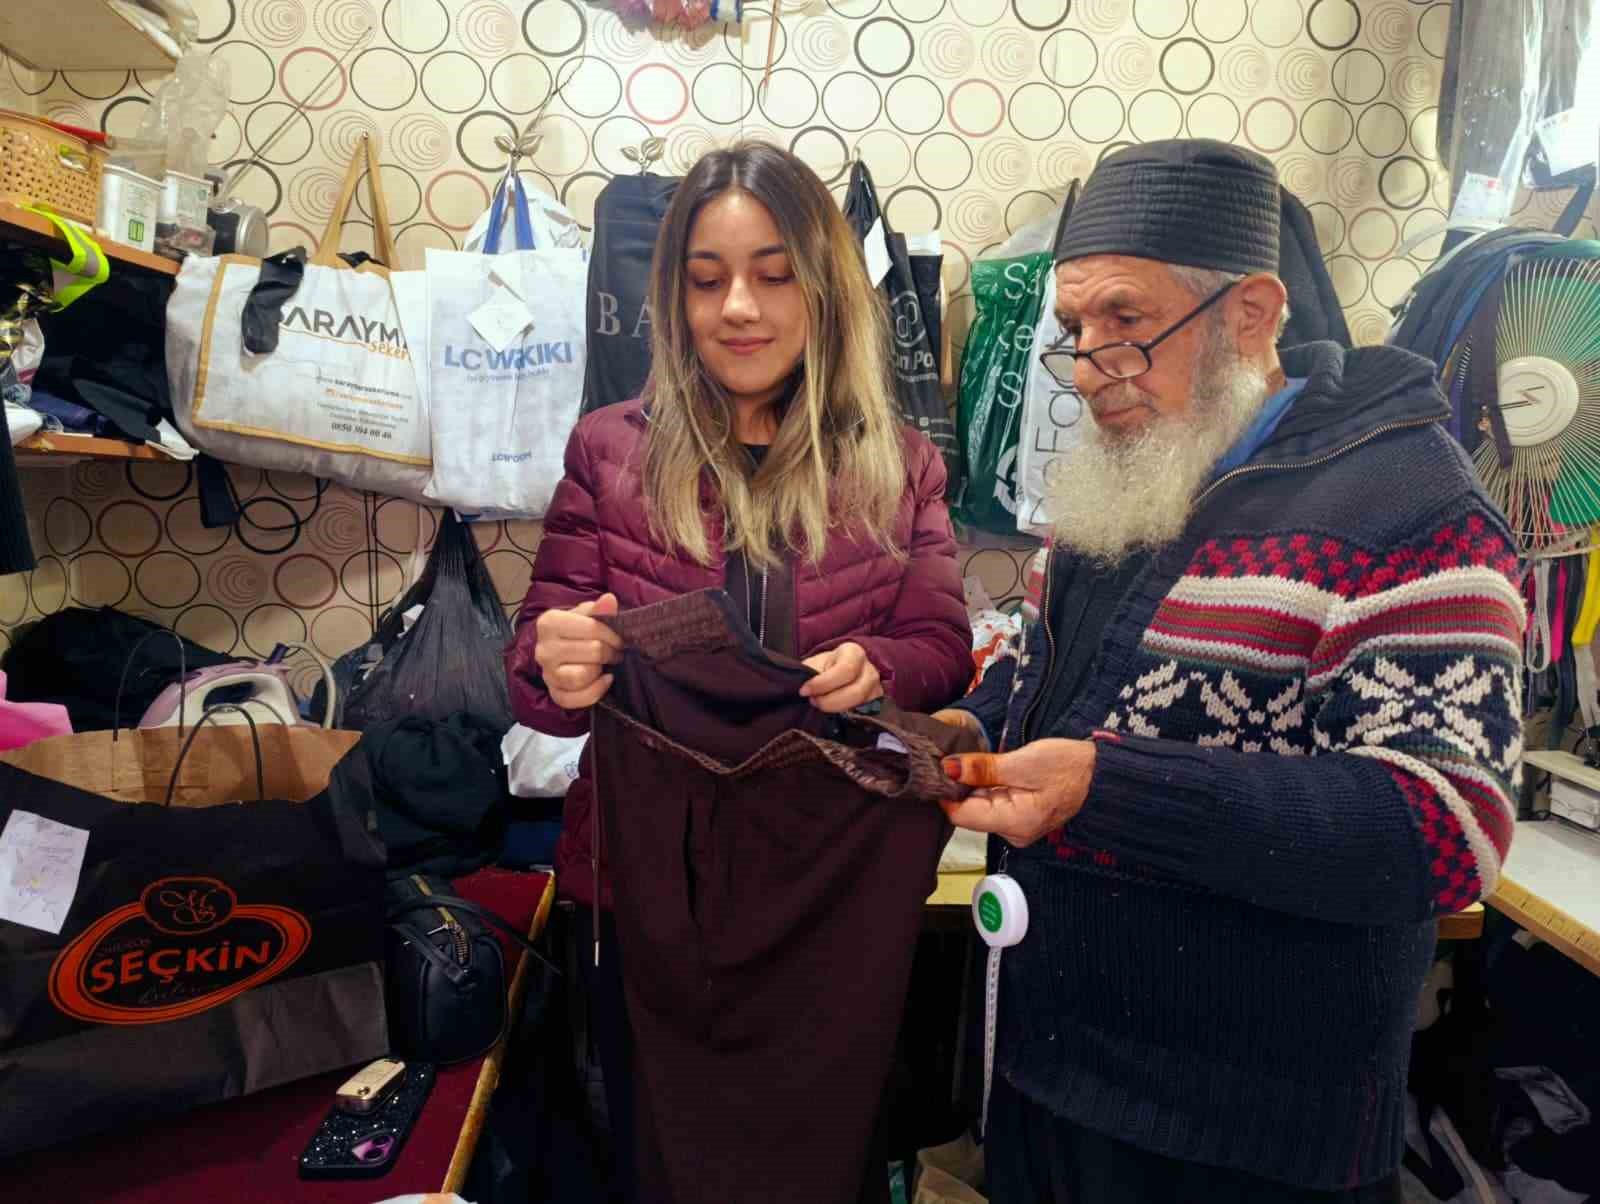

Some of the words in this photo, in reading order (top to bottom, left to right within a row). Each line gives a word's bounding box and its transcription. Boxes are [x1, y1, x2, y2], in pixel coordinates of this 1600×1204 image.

[281, 305, 409, 350] ARAYM
[444, 345, 482, 370] LC
[484, 341, 572, 370] WKIKI
[89, 940, 271, 993] SEÇKİN
